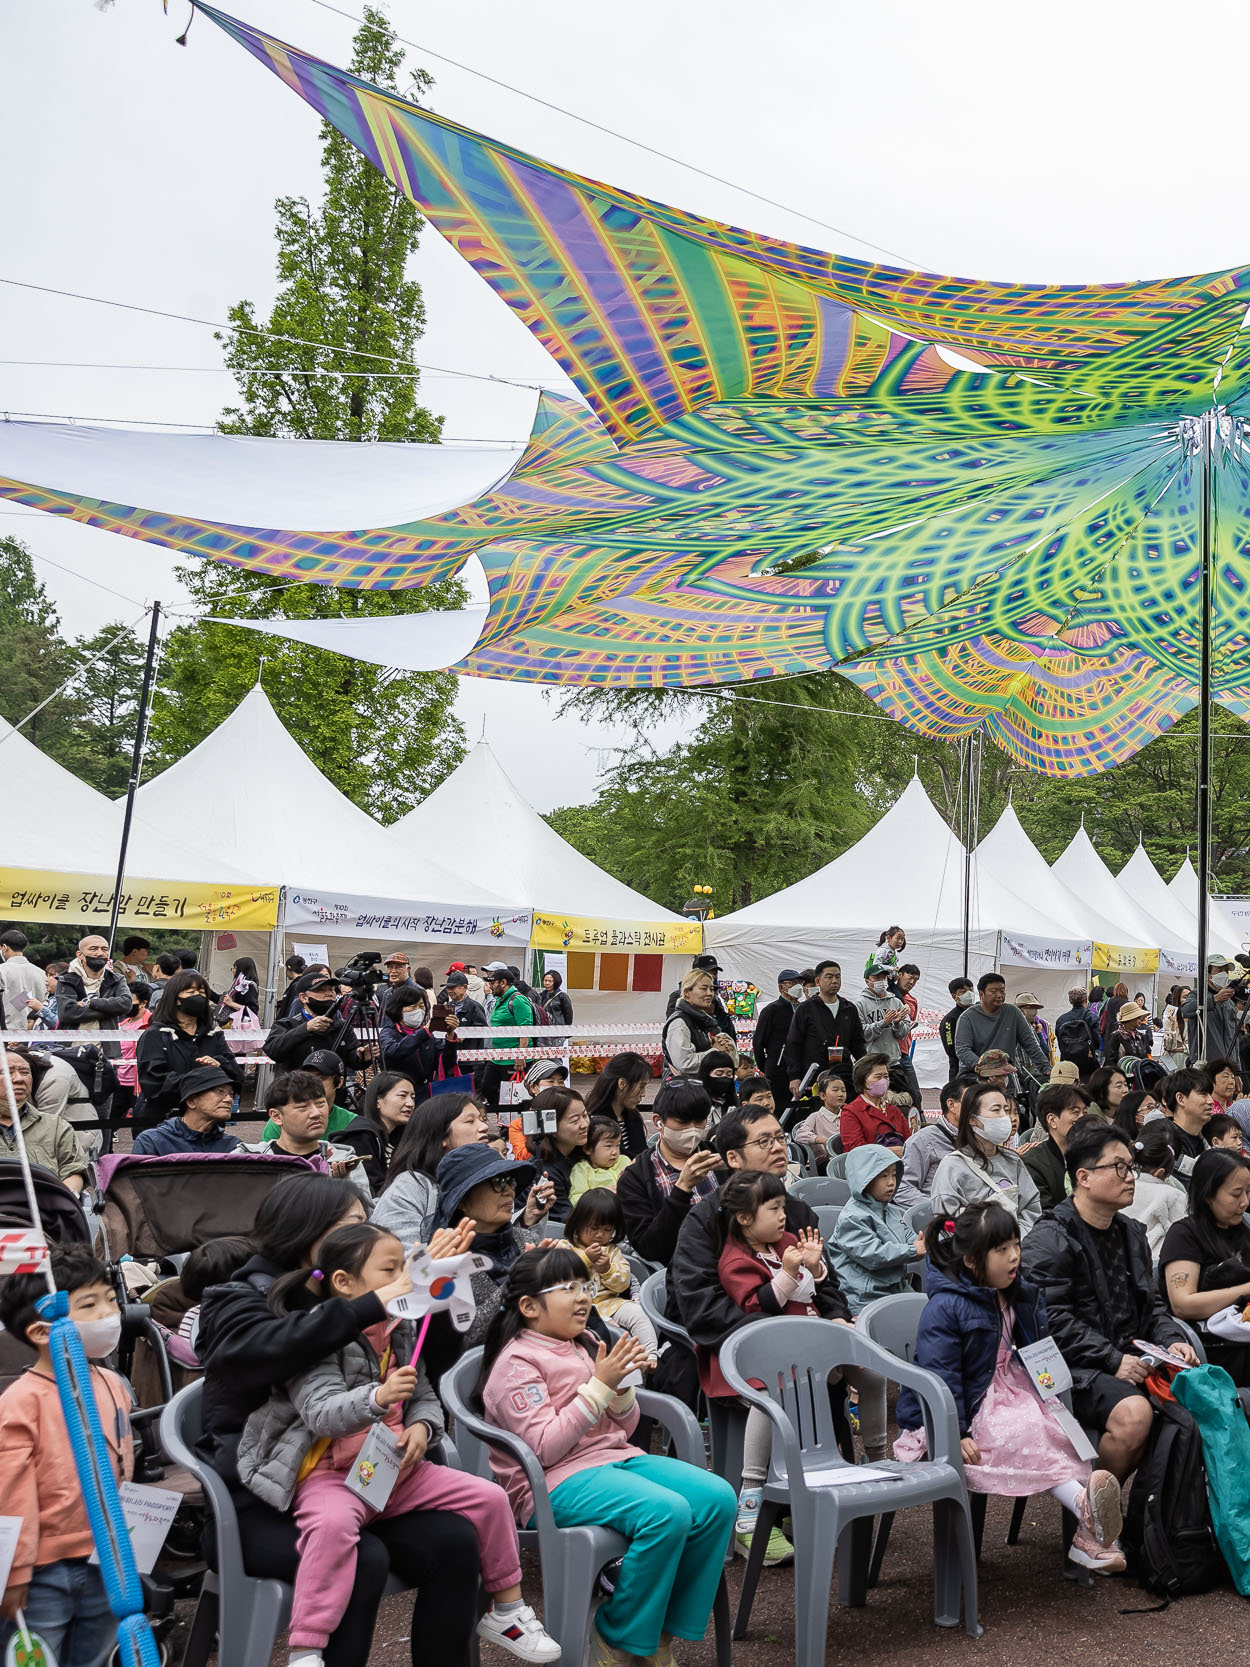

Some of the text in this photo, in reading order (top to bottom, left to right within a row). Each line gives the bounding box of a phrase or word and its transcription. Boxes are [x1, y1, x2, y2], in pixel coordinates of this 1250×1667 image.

[11, 891, 70, 911] 업싸이클
[134, 895, 188, 918] 만들기
[355, 913, 478, 935] 업싸이클의 시작 장난감분해
[610, 929, 642, 946] 플라스틱
[643, 931, 666, 947] 전시관
[511, 1385, 543, 1412] 03
[143, 1500, 176, 1512] PASSPORT
